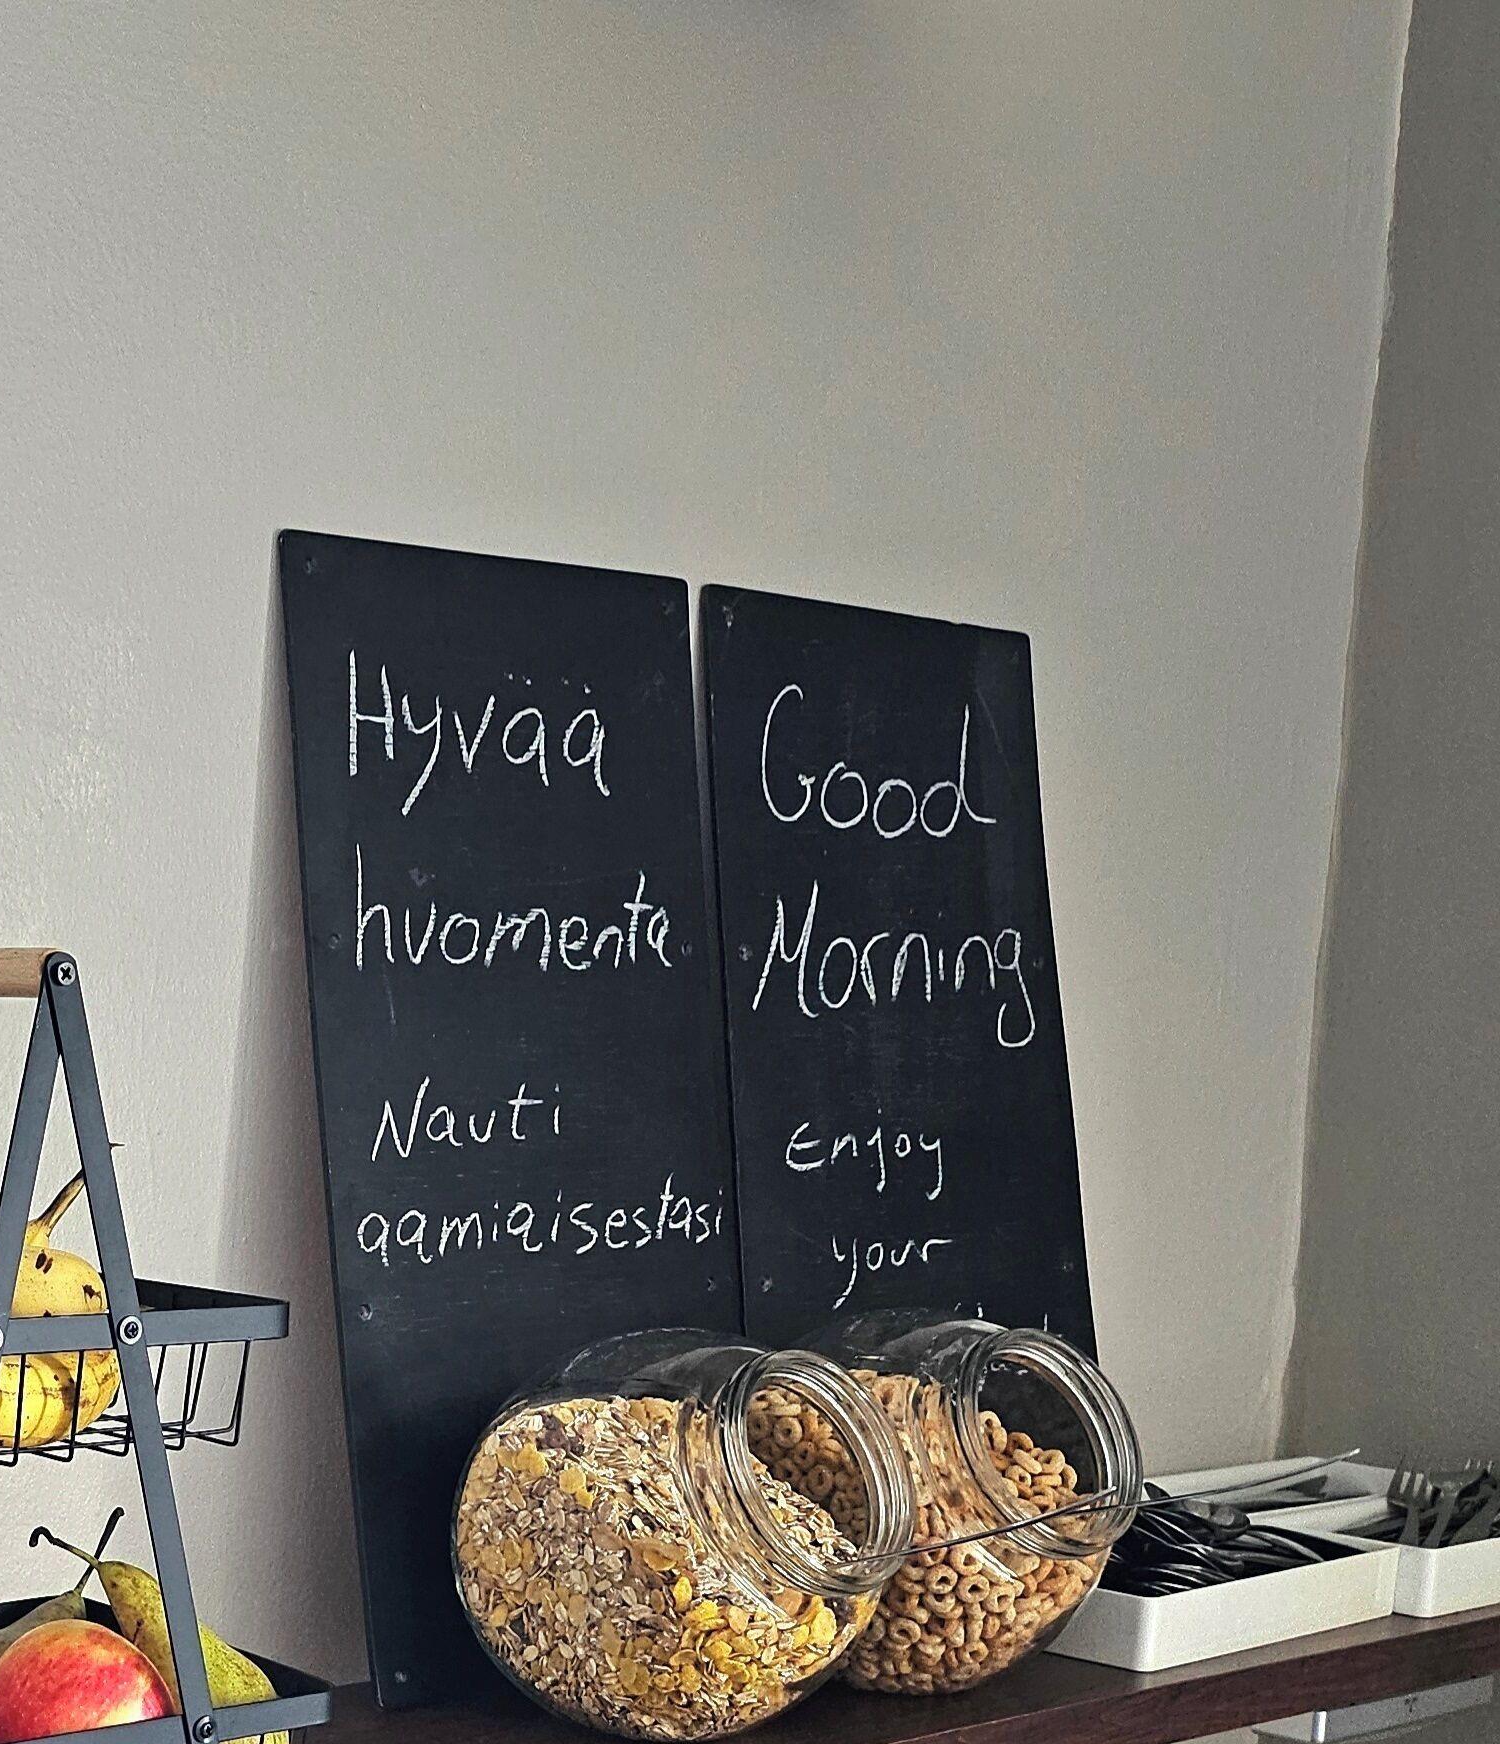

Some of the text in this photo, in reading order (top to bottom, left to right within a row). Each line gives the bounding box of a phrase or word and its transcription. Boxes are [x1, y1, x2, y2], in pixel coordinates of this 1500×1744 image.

[348, 649, 612, 816] Hyvää
[759, 683, 998, 839] Good
[354, 842, 675, 970] huomenta
[751, 880, 1037, 1048] Morning
[371, 1076, 562, 1162] Nauti
[784, 1108, 945, 1201] Enjoy
[356, 1172, 725, 1266] aamiaisestasi
[831, 1234, 954, 1311] your
